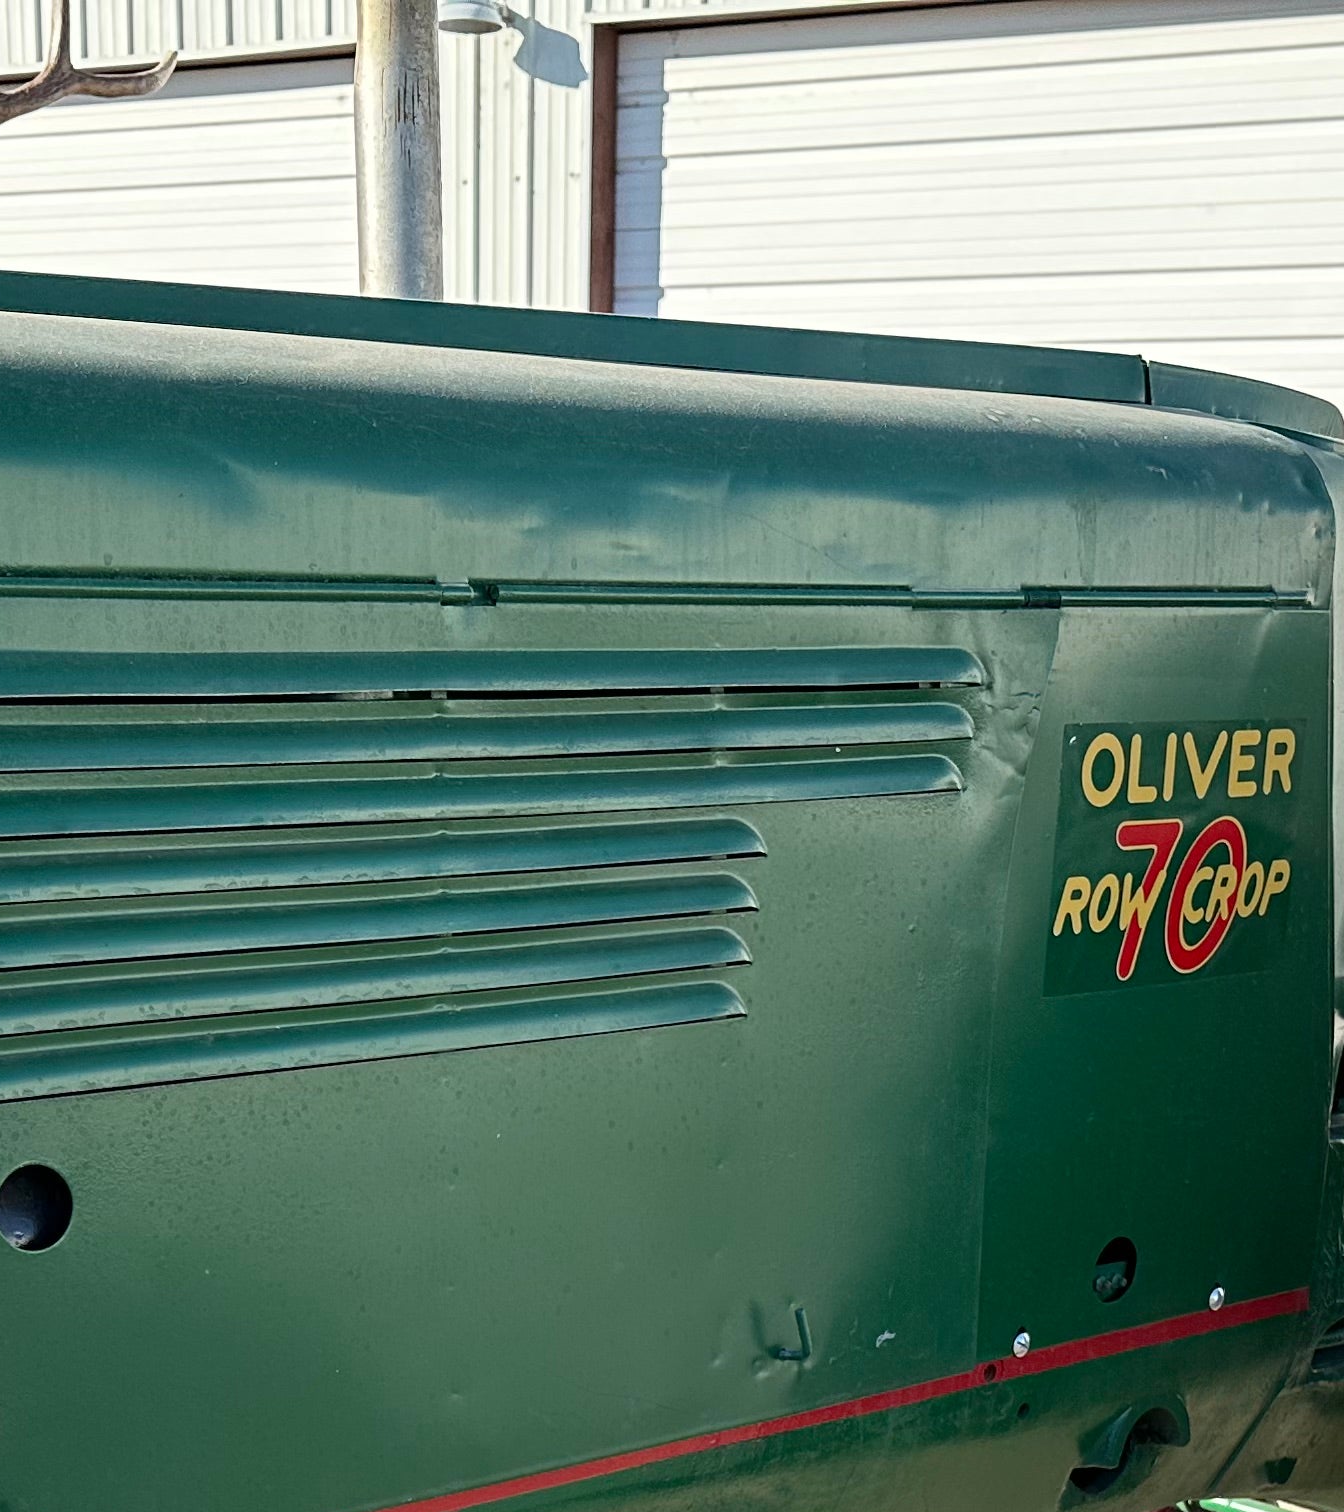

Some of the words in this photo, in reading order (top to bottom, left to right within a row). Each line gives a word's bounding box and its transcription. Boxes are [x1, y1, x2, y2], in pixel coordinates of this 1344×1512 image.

[1082, 728, 1296, 808] OLIVER
[1053, 868, 1167, 936] ROW
[1183, 859, 1291, 924] CROP
[1116, 816, 1248, 981] 70
